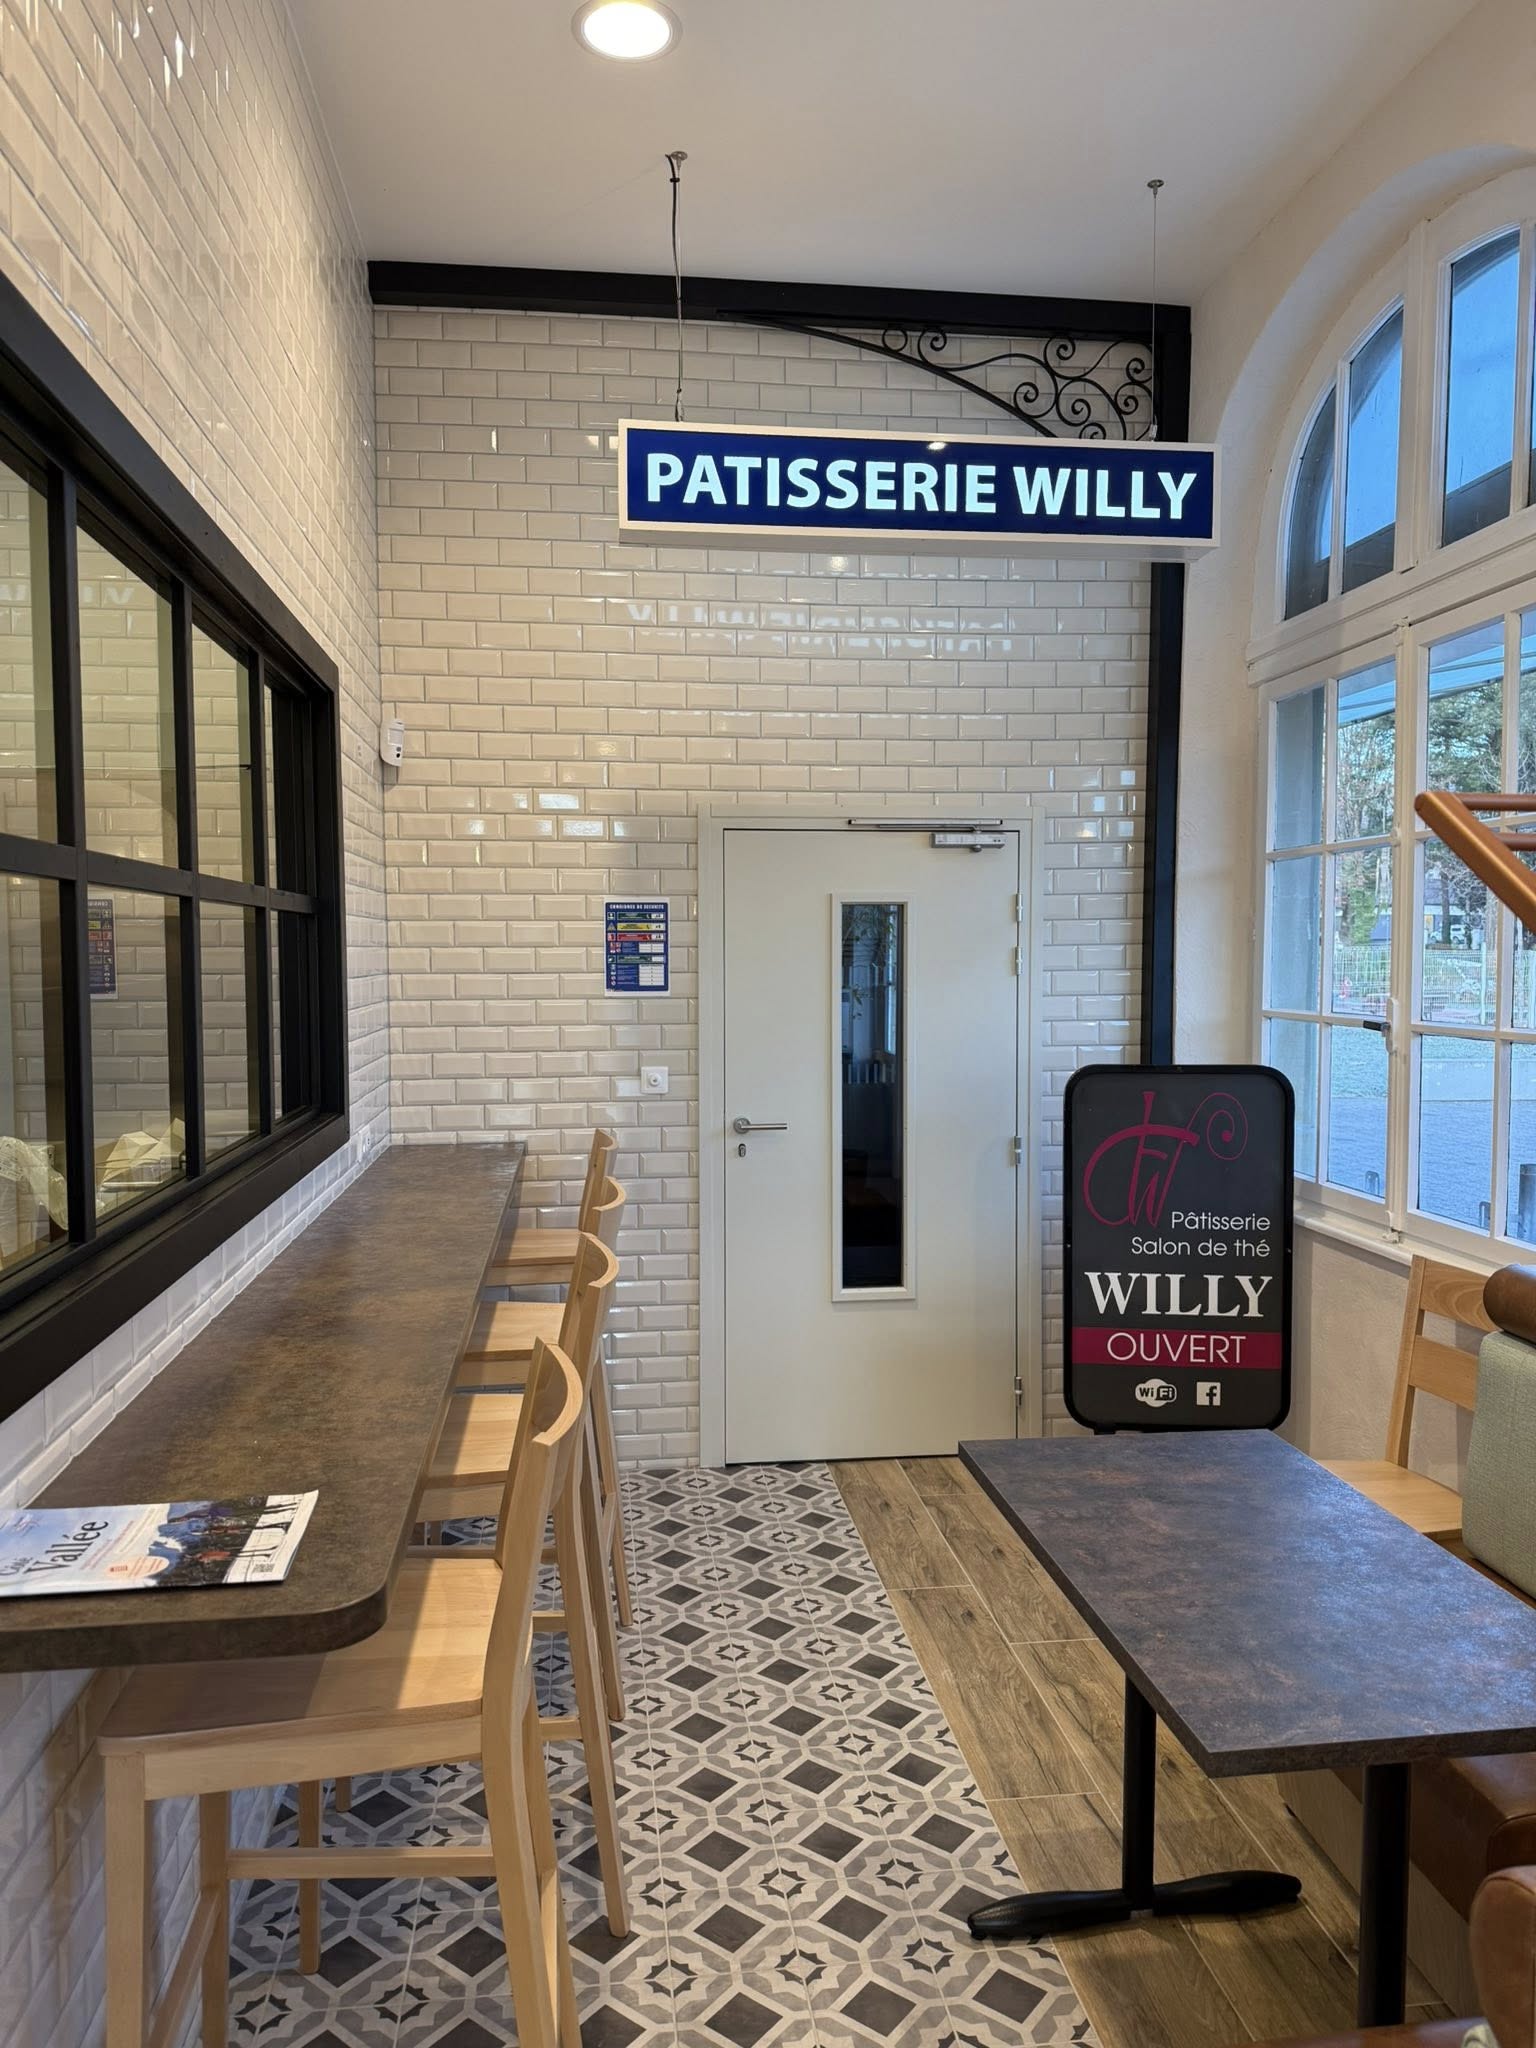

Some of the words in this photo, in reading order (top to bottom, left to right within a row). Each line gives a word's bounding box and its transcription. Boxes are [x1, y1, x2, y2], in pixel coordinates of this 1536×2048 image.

[646, 452, 997, 514] PATISSERIE
[1013, 466, 1197, 520] WILLY
[1171, 1211, 1270, 1231] Pâtisserie
[1131, 1236, 1191, 1256] Salon
[1198, 1238, 1227, 1256] de
[1234, 1238, 1270, 1257] thé
[1084, 1271, 1273, 1318] WILLY
[1107, 1332, 1246, 1364] OUVERT
[24, 1520, 109, 1574] Vallée
